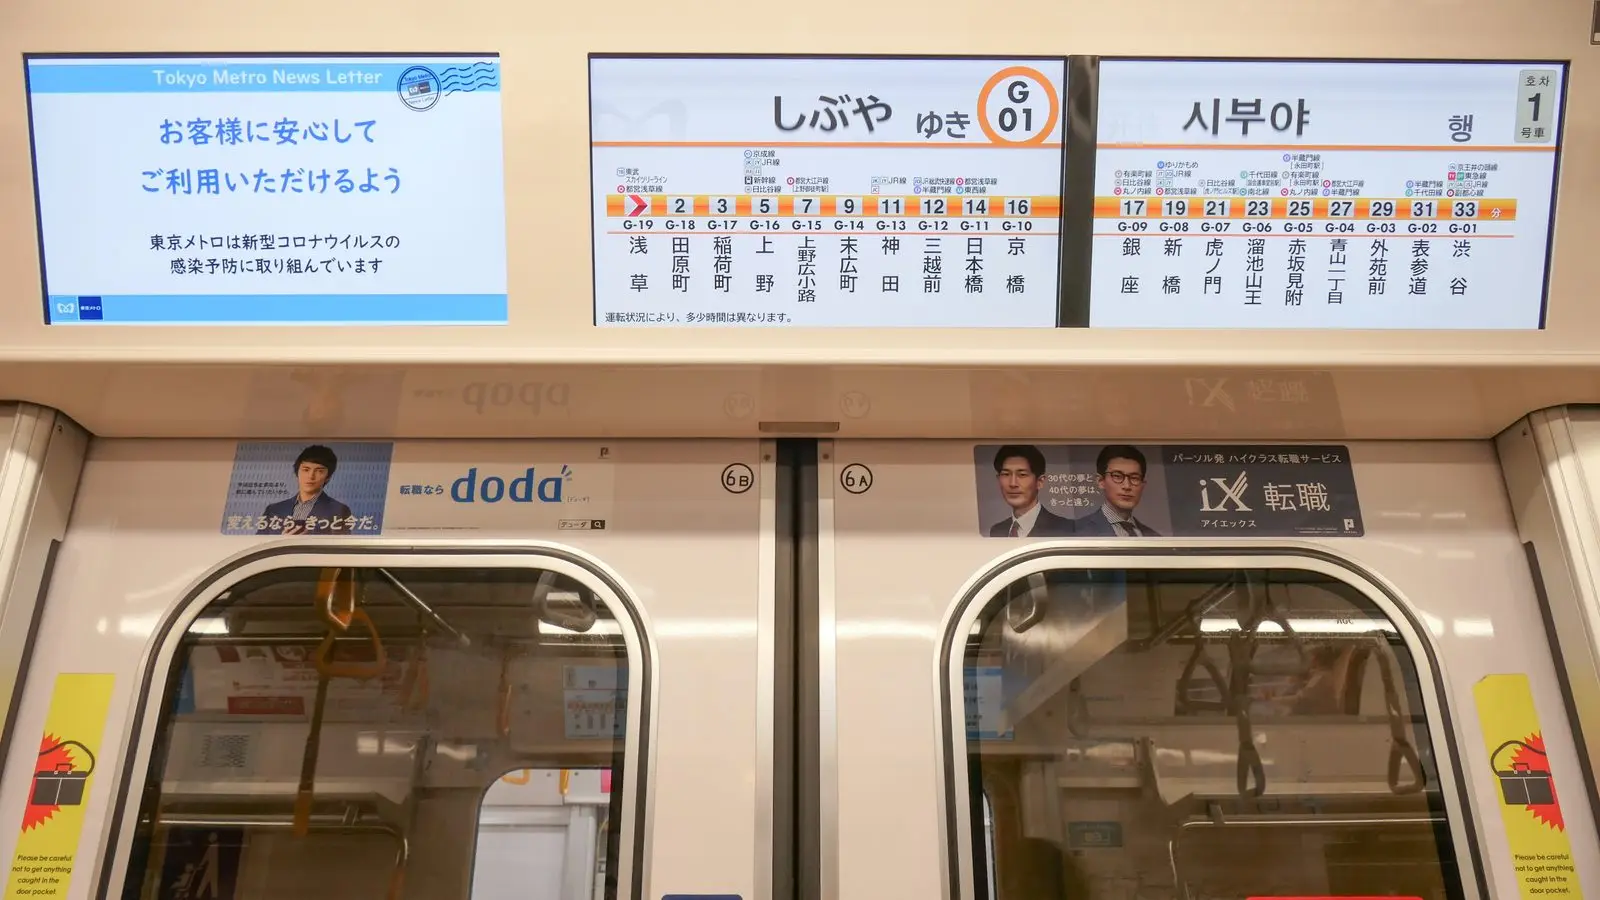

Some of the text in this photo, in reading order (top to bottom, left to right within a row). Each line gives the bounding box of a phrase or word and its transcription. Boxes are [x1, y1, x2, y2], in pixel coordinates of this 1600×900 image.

[152, 68, 383, 89] Tokyo Metro News Letter
[1525, 76, 1550, 87] 호차
[1007, 81, 1029, 103] G
[773, 94, 971, 139] しぶや ゆき
[1528, 93, 1541, 121] 1
[998, 108, 1033, 132] 01
[1182, 97, 1474, 142] 시부야 행
[159, 118, 378, 146] お客様に安心して
[1521, 127, 1545, 138] 号車
[1124, 170, 1152, 178] 有楽町線
[1165, 161, 1198, 169] ゆりかもめ
[141, 168, 402, 195] ご利用いただけるよう
[1122, 179, 1151, 187] 日比谷線
[1207, 179, 1235, 187] 日比谷線
[1290, 171, 1319, 179] 有楽町線
[753, 185, 782, 194] 日比谷線
[965, 186, 986, 194] 東西線
[1122, 187, 1151, 195] 丸ノ内線
[1248, 188, 1270, 196] 南北線
[1289, 188, 1318, 196] 丸ノ内線
[675, 198, 1028, 214] 2 3 5 7 9 11 12 14 16
[1124, 200, 1501, 219] 17 19 21 23 25 27 29 31 33 分
[623, 220, 1032, 230] G-19 G-18 G-17 G-16 G-15 G-14 G-13 G-12 G-11 G-10
[1118, 222, 1477, 233] G-09 G-08 G-07 G-06 G-05 G-04 G-03 G-02 G-01
[149, 233, 401, 251] 東京メトロは新型コロナウイルスの
[170, 258, 383, 275] 感染予防に取り組んでいます
[629, 236, 649, 292] 浅草
[672, 237, 690, 292] 田原町
[713, 236, 732, 292] 稲荷町
[755, 236, 774, 292] 上野
[797, 236, 816, 303] 上野広小路
[839, 236, 858, 292] 末広町
[882, 236, 900, 293] 神田
[923, 238, 942, 293] 三越前
[965, 237, 984, 294] 日本橋
[1006, 237, 1026, 294] 京橋
[1121, 238, 1141, 294] 銀座
[1162, 238, 1182, 294] 新橋
[1204, 239, 1223, 294] 虎ノ門
[1244, 239, 1265, 305] 溜池山王
[1285, 239, 1306, 306] 赤坂見附
[1328, 239, 1346, 304] 青山一丁目
[1368, 239, 1388, 295] 外苑前
[1408, 239, 1430, 295] 表参道
[1450, 240, 1471, 295] 渋谷
[604, 311, 791, 324] 運転状況により、多少時間は異なります。
[1173, 453, 1342, 464] パーソル発 ハイクラス転職サービス
[400, 466, 564, 503] 転職なら doda
[1048, 473, 1093, 482] 30代の夢と
[1049, 486, 1100, 494] 40代の夢は、
[1263, 482, 1331, 512] 転職
[1050, 498, 1094, 507] きっと違う。
[226, 515, 380, 532] 変えるなら、きっと今だ。
[1201, 519, 1257, 528] アイエックス
[17, 854, 72, 862] Please be careful
[31, 866, 43, 874] get
[43, 865, 72, 874] anything
[1534, 865, 1545, 873] get
[1546, 865, 1574, 873] anything
[17, 877, 41, 885] caught
[1525, 876, 1548, 884] caught
